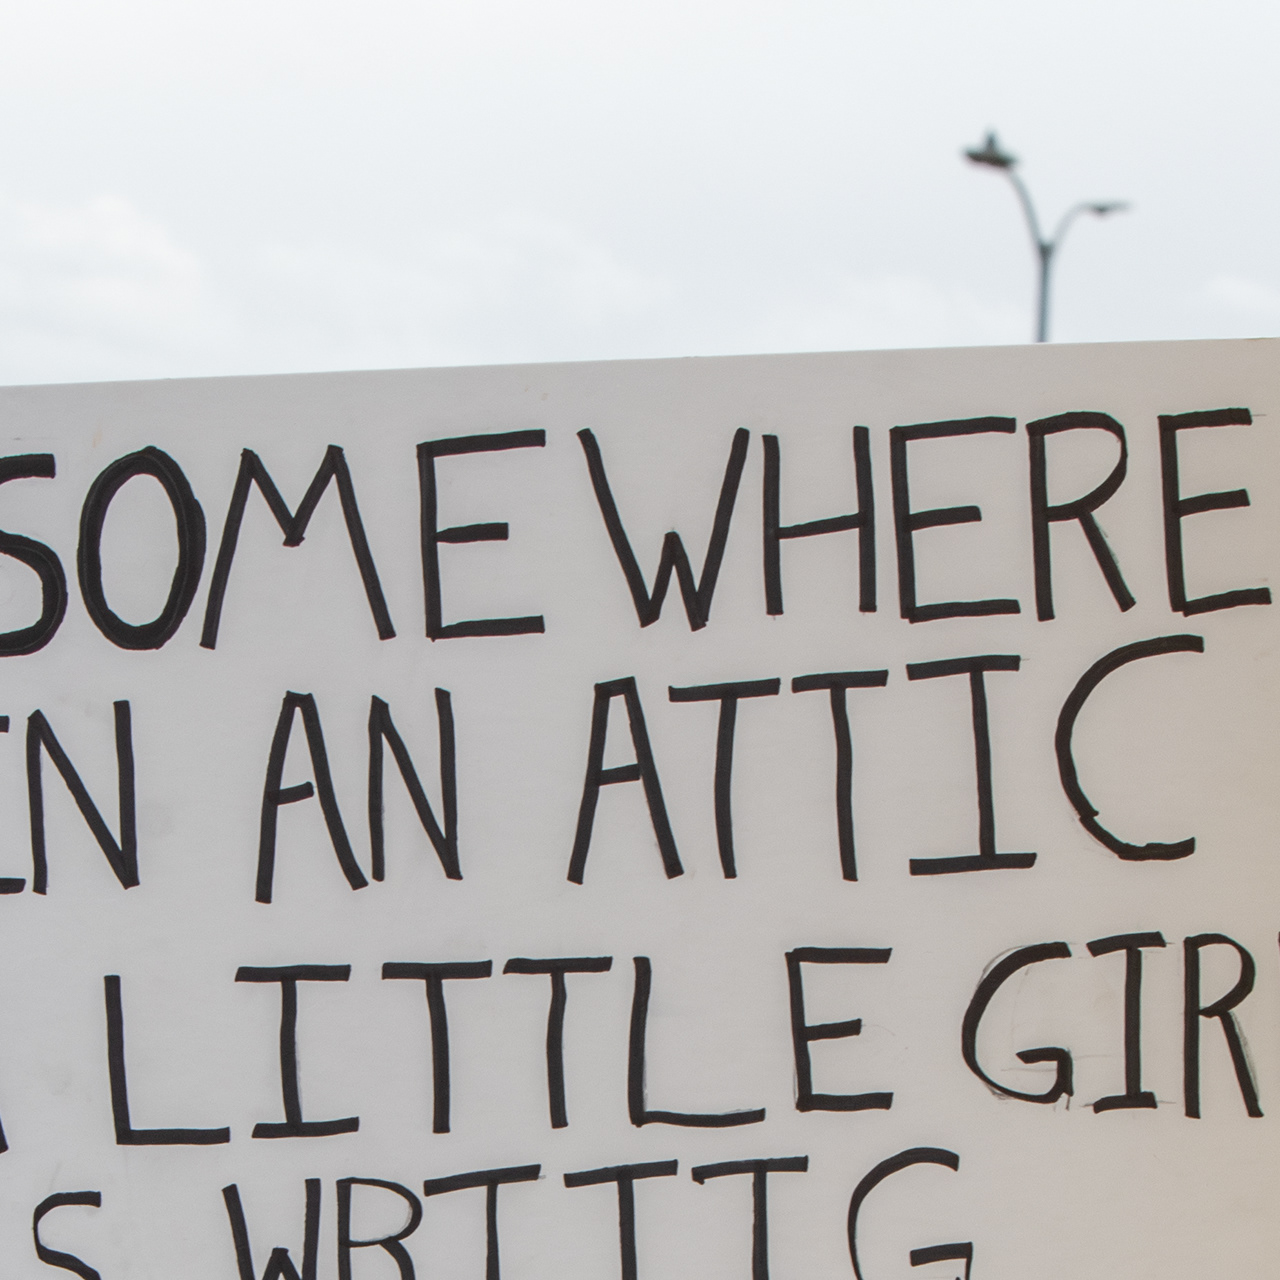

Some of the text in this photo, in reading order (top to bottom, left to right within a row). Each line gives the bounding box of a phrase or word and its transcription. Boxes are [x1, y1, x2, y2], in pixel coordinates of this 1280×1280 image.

[256, 688, 463, 903] AN
[568, 635, 1204, 884] ATTIC
[104, 947, 893, 1145] LITTLE
